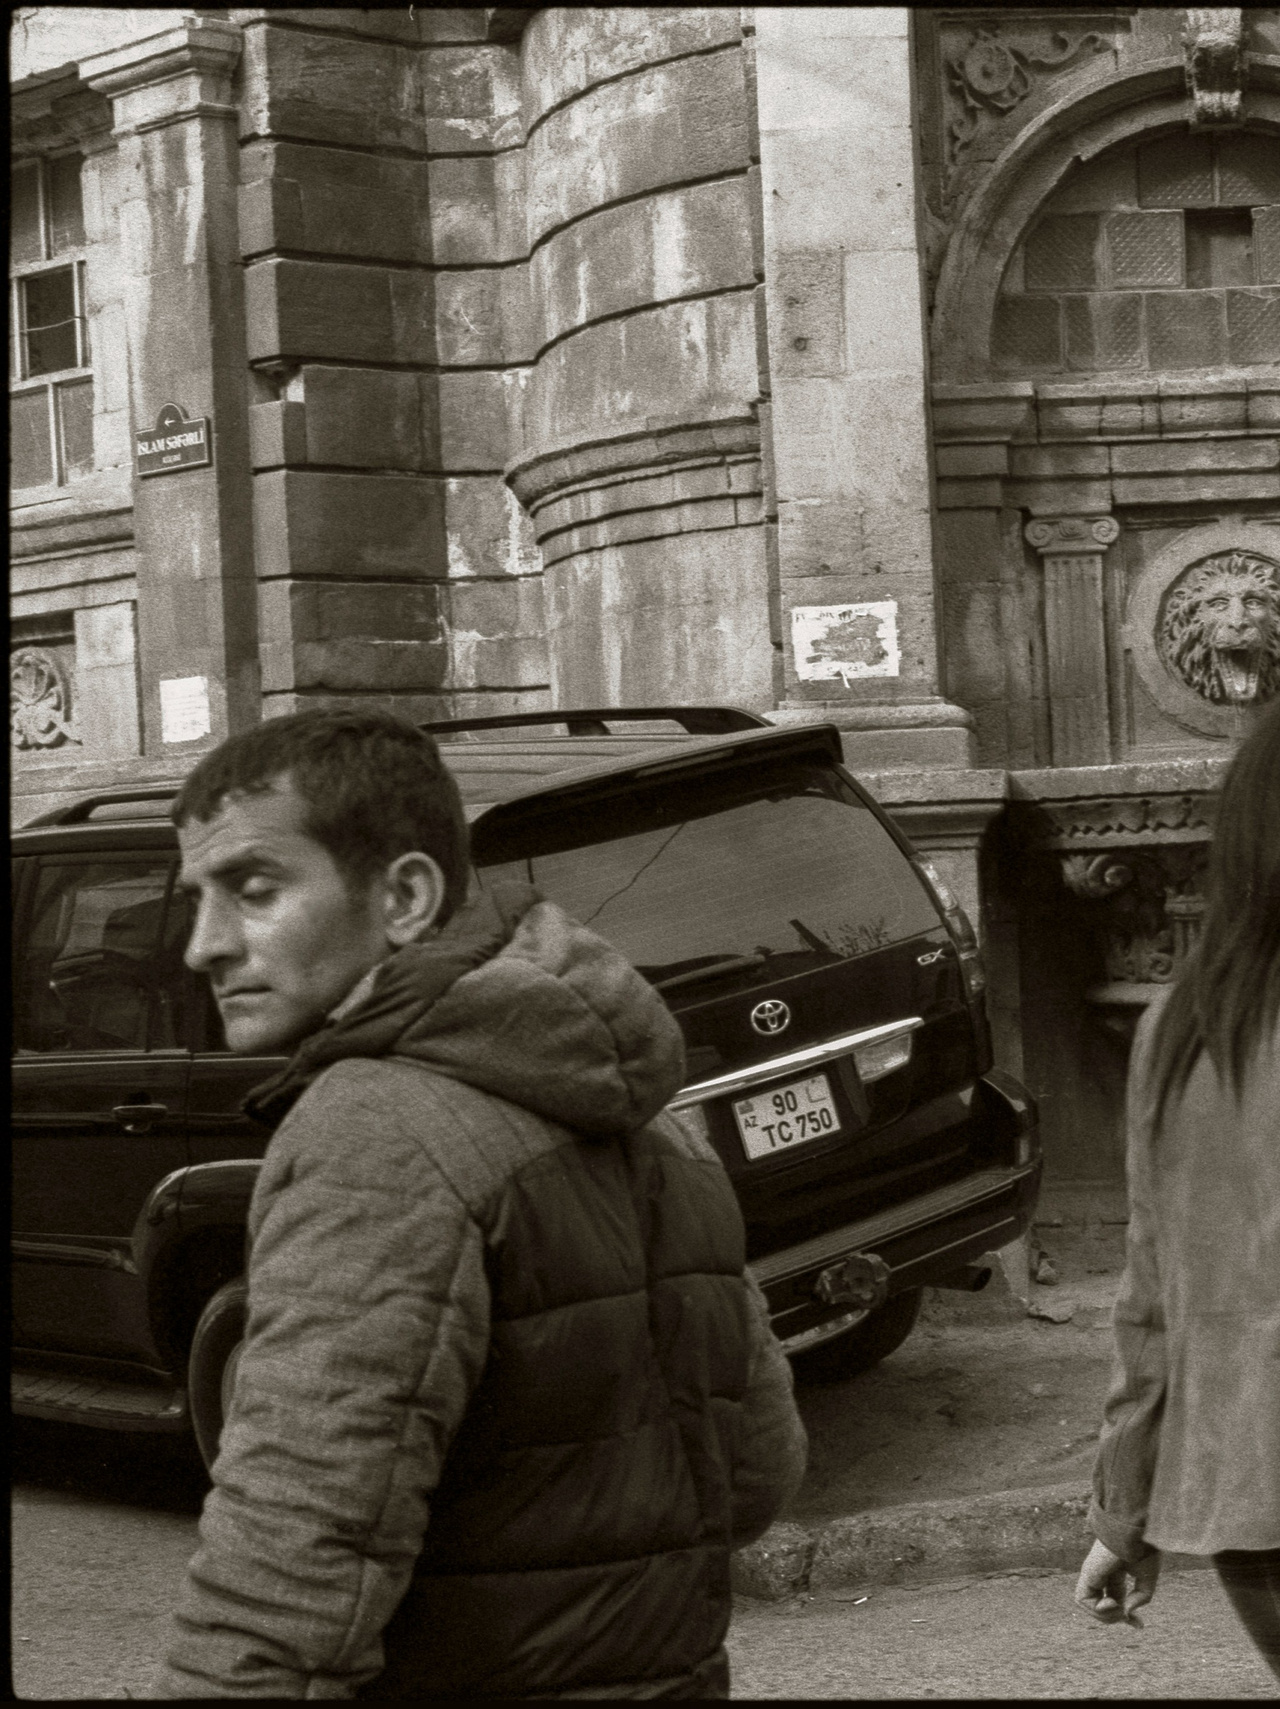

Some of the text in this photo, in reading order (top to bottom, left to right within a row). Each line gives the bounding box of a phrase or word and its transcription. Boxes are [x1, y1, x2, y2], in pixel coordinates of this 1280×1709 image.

[772, 1090, 798, 1116] 90
[744, 1115, 759, 1129] AZ
[761, 1107, 833, 1147] TC 750
